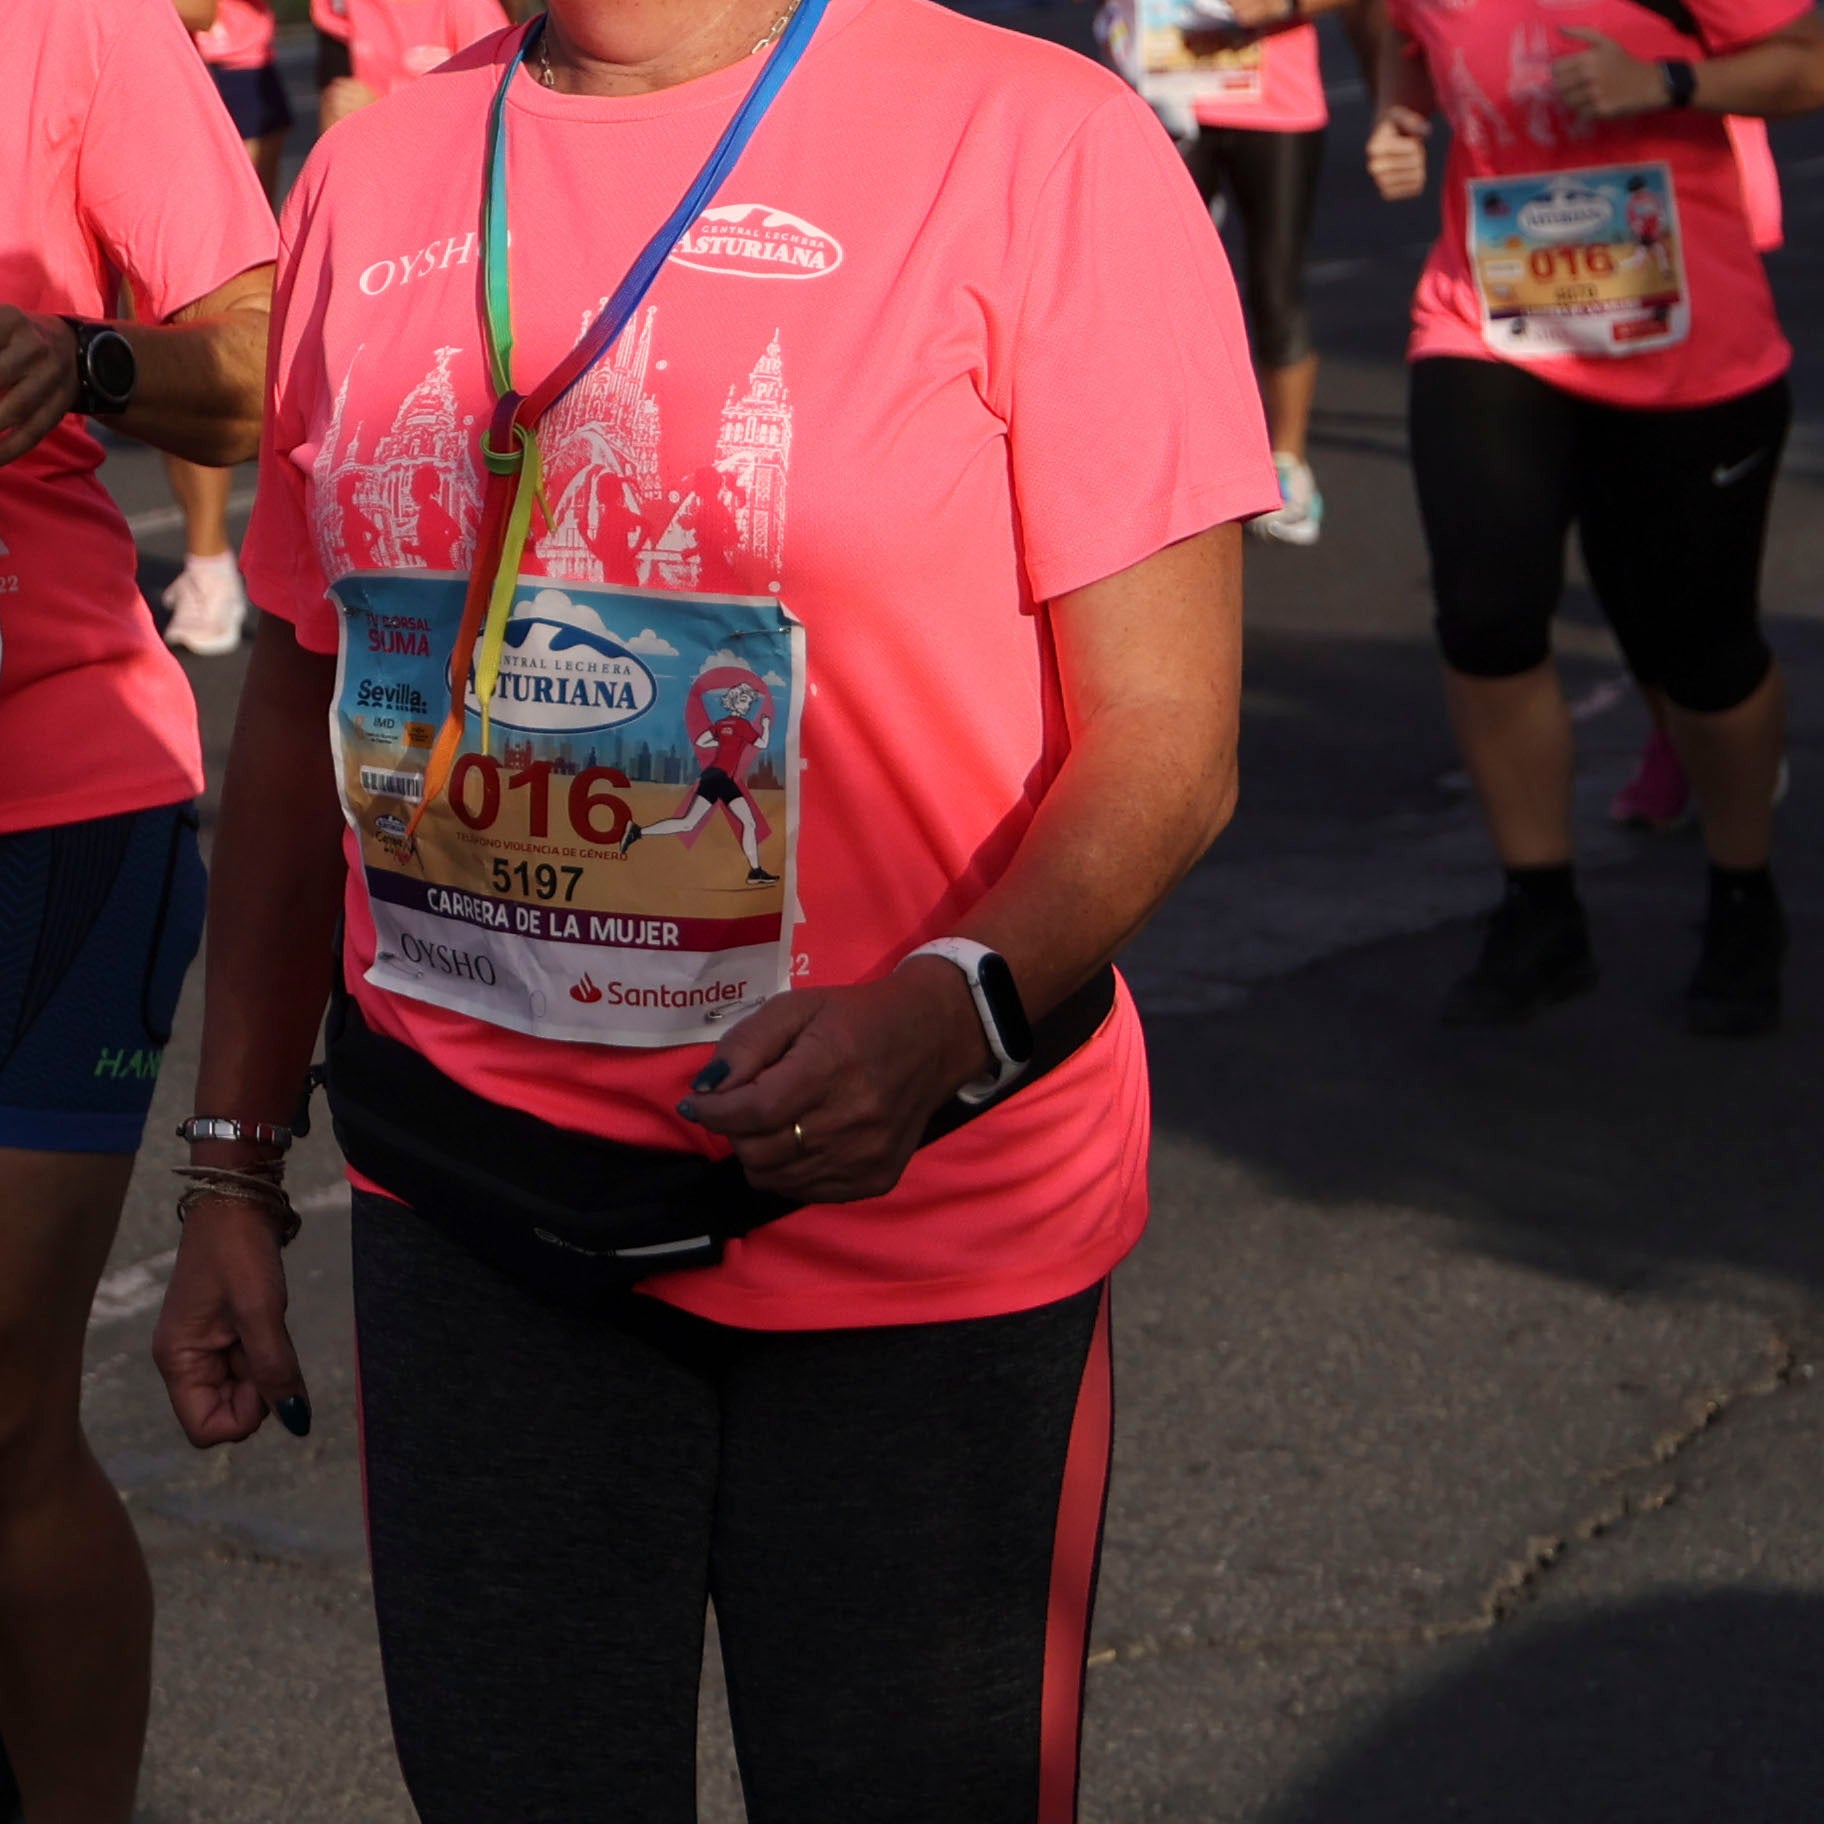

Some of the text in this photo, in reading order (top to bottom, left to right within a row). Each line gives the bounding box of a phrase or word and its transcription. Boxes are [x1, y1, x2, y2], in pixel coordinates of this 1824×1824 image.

[672, 230, 826, 270] ASTURIANA
[701, 225, 825, 249] CENTRAL LECHERA
[1530, 244, 1615, 281] 016
[368, 628, 431, 656] SUMA
[554, 660, 631, 676] LECHERA
[373, 717, 395, 729] IMD
[448, 752, 633, 846] 016
[503, 840, 560, 857] VIOLENCIA
[562, 847, 578, 858] DE
[579, 847, 629, 862] GÉNERO
[491, 857, 584, 902] 5197
[426, 887, 679, 946] CARRERA DE LA MUJER
[401, 931, 497, 987] OYSHO
[608, 978, 748, 1009] Santander
